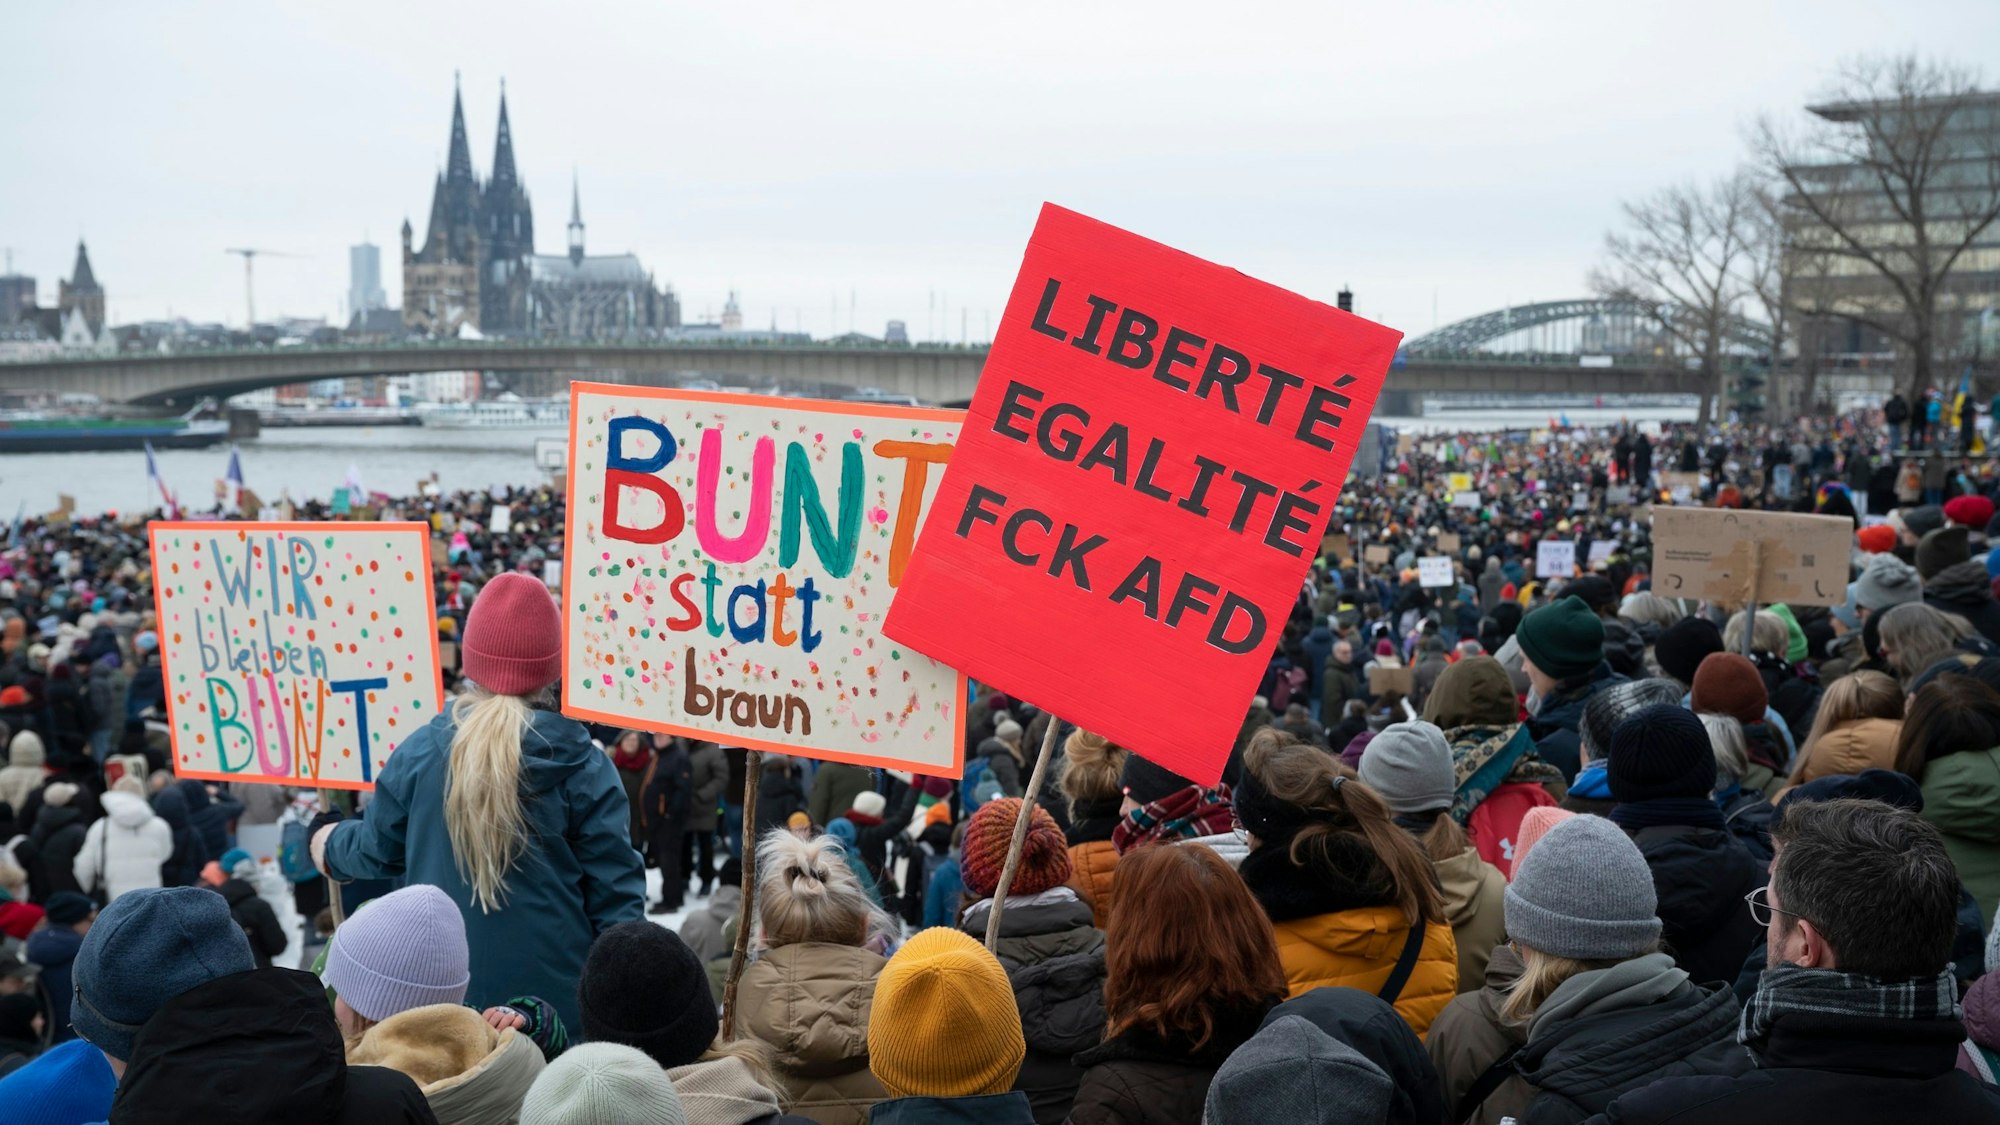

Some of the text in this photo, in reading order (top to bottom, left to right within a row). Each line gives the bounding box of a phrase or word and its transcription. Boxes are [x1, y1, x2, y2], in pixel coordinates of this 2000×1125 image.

[1031, 278, 1357, 452] LIBERTÉ
[602, 416, 954, 588] BUNT
[992, 380, 1321, 558] EGALITÉ
[209, 536, 317, 620] WIR
[666, 563, 822, 653] statt
[955, 484, 1267, 655] FCK AFD
[195, 606, 328, 680] bleiben
[684, 647, 811, 735] braun
[205, 672, 388, 783] BUNT
